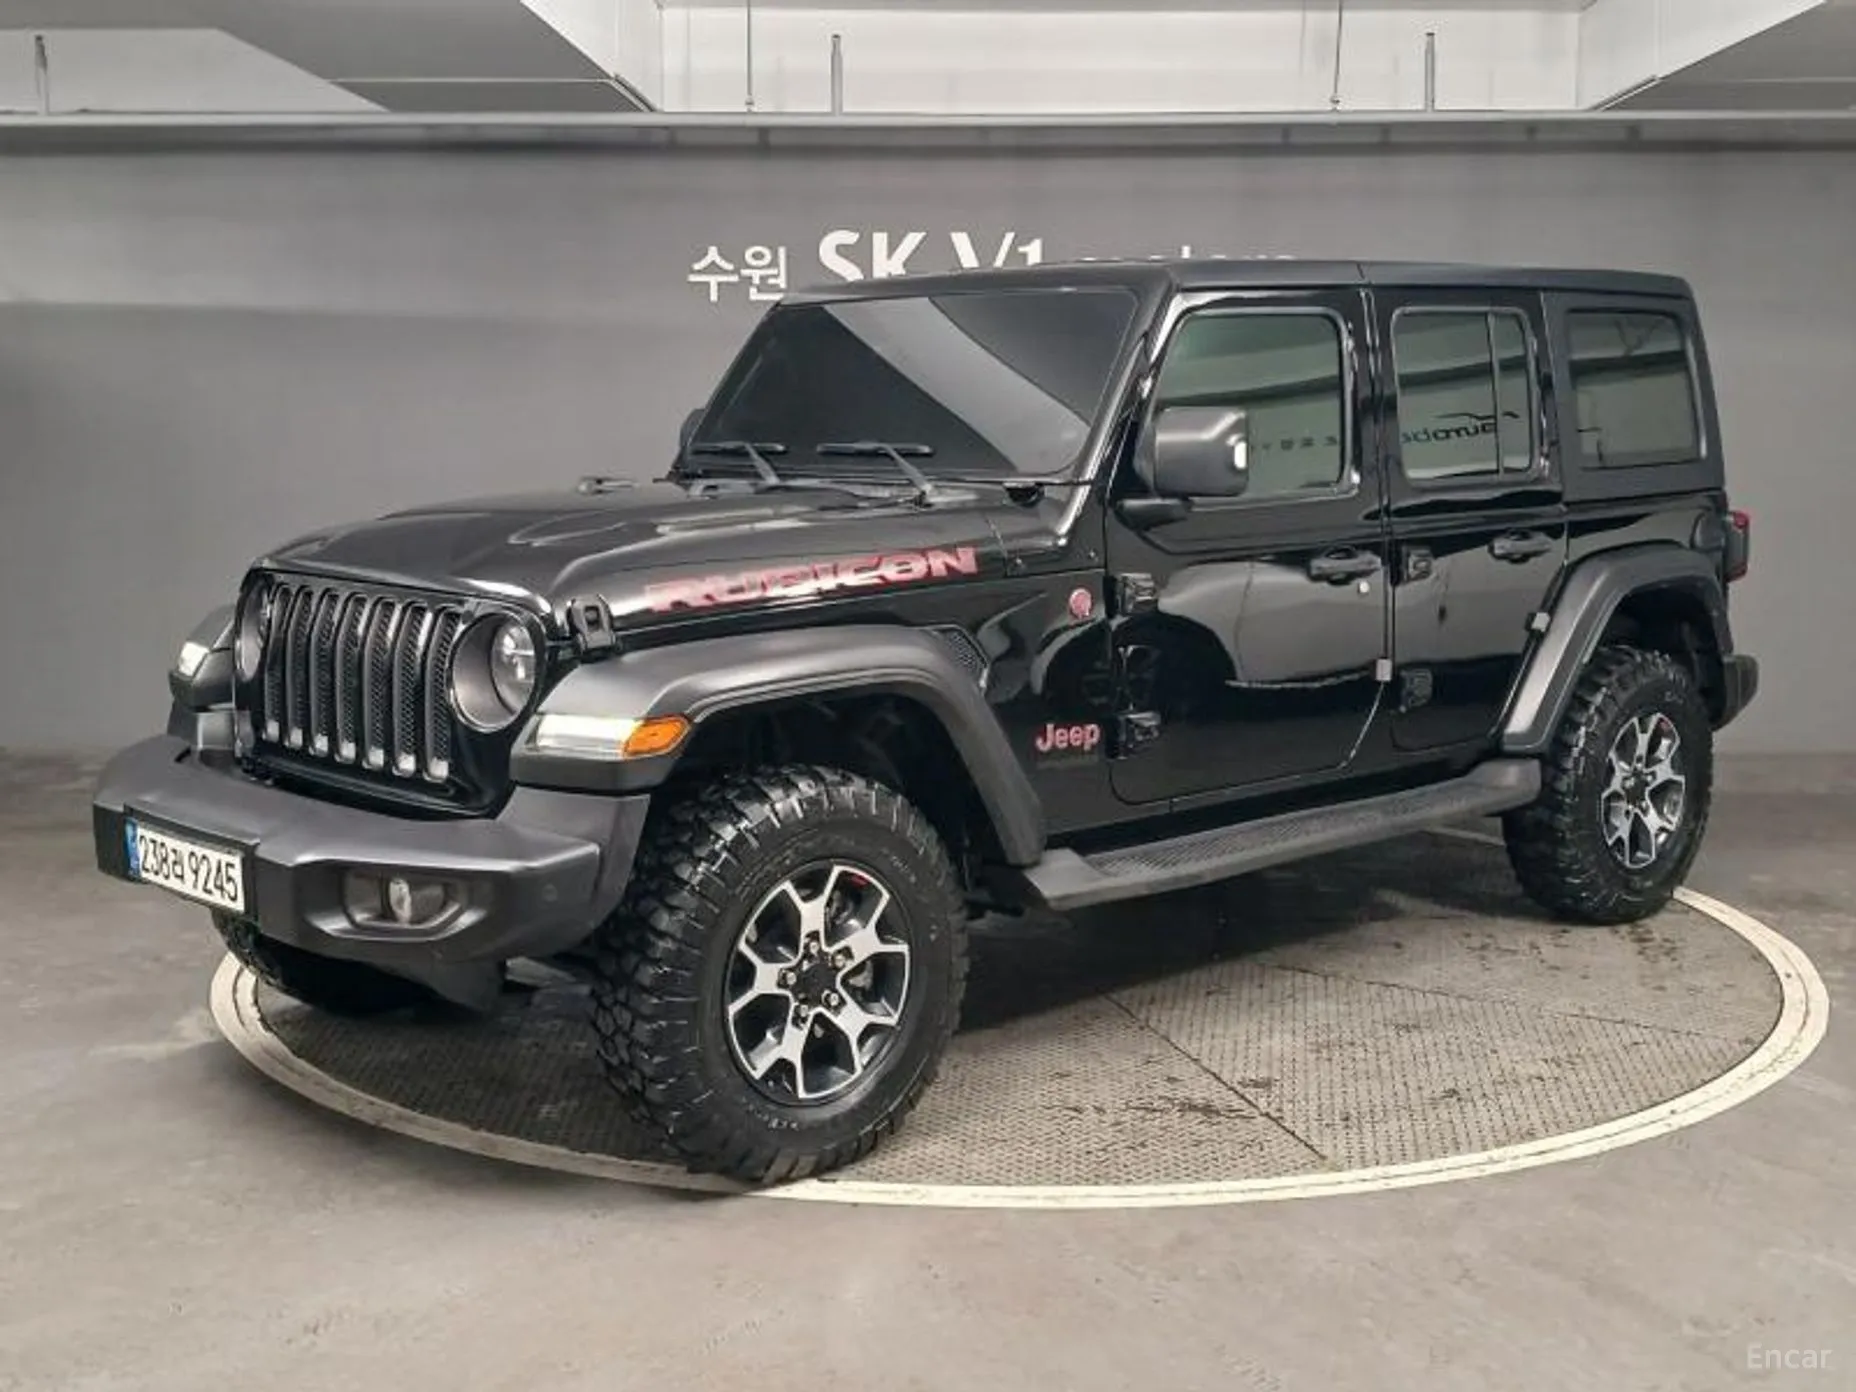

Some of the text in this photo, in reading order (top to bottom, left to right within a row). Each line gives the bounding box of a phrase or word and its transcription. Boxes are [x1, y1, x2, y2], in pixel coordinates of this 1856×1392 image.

[687, 229, 1042, 302] 수원 SK V1
[645, 546, 978, 612] RUBICON
[1035, 722, 1101, 752] Jeep
[187, 850, 239, 903] 9245
